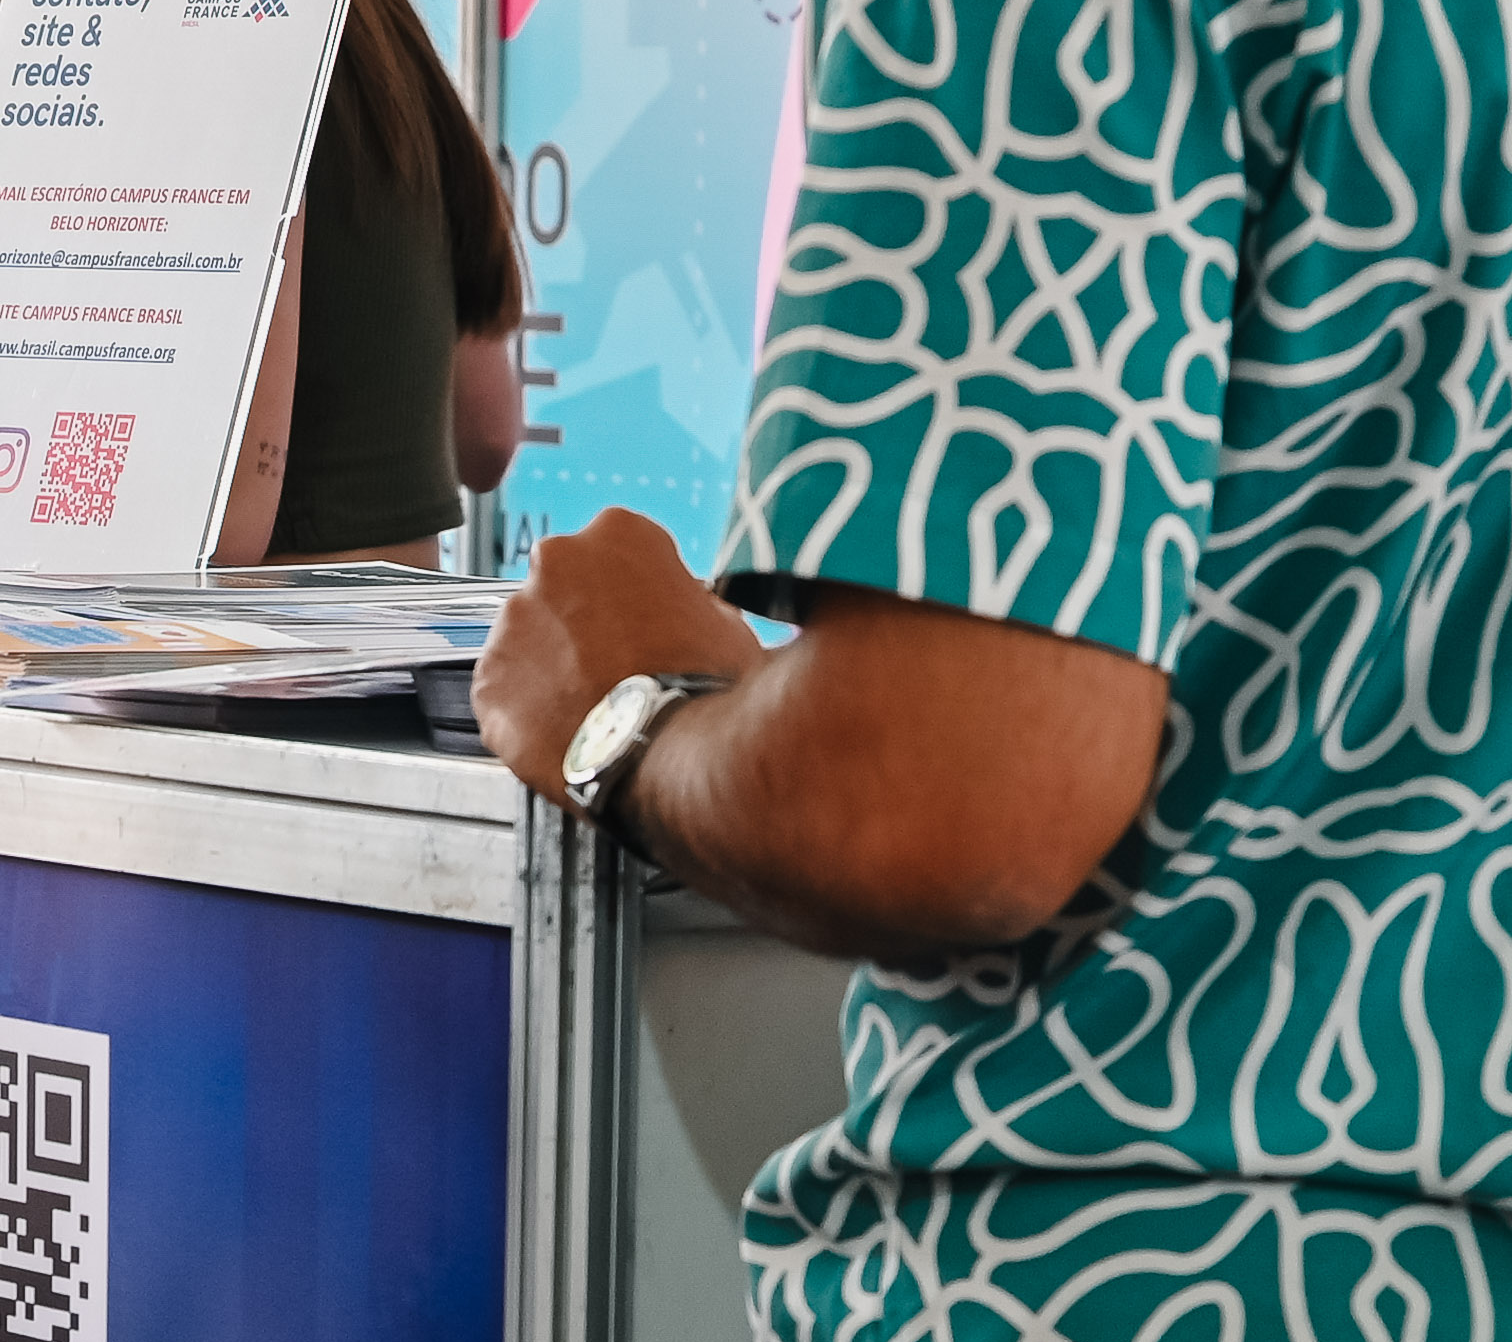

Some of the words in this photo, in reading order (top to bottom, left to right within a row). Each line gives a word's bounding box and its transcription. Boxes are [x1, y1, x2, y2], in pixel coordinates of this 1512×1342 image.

[183, 5, 240, 19] FRANCE
[21, 14, 74, 47] site
[81, 14, 102, 47] &
[12, 54, 93, 87] redes
[1, 94, 105, 127] sociais.
[30, 183, 107, 203] ESCRITÓRIO
[110, 187, 169, 204] CAMPUS
[171, 188, 226, 205] FRANCE
[227, 189, 251, 205] EM
[50, 215, 84, 231] BELO
[86, 216, 169, 233] HORIZONTE:
[22, 305, 79, 322] CAMPUS
[81, 307, 134, 323] FRANCE
[137, 308, 183, 325] BRASIL
